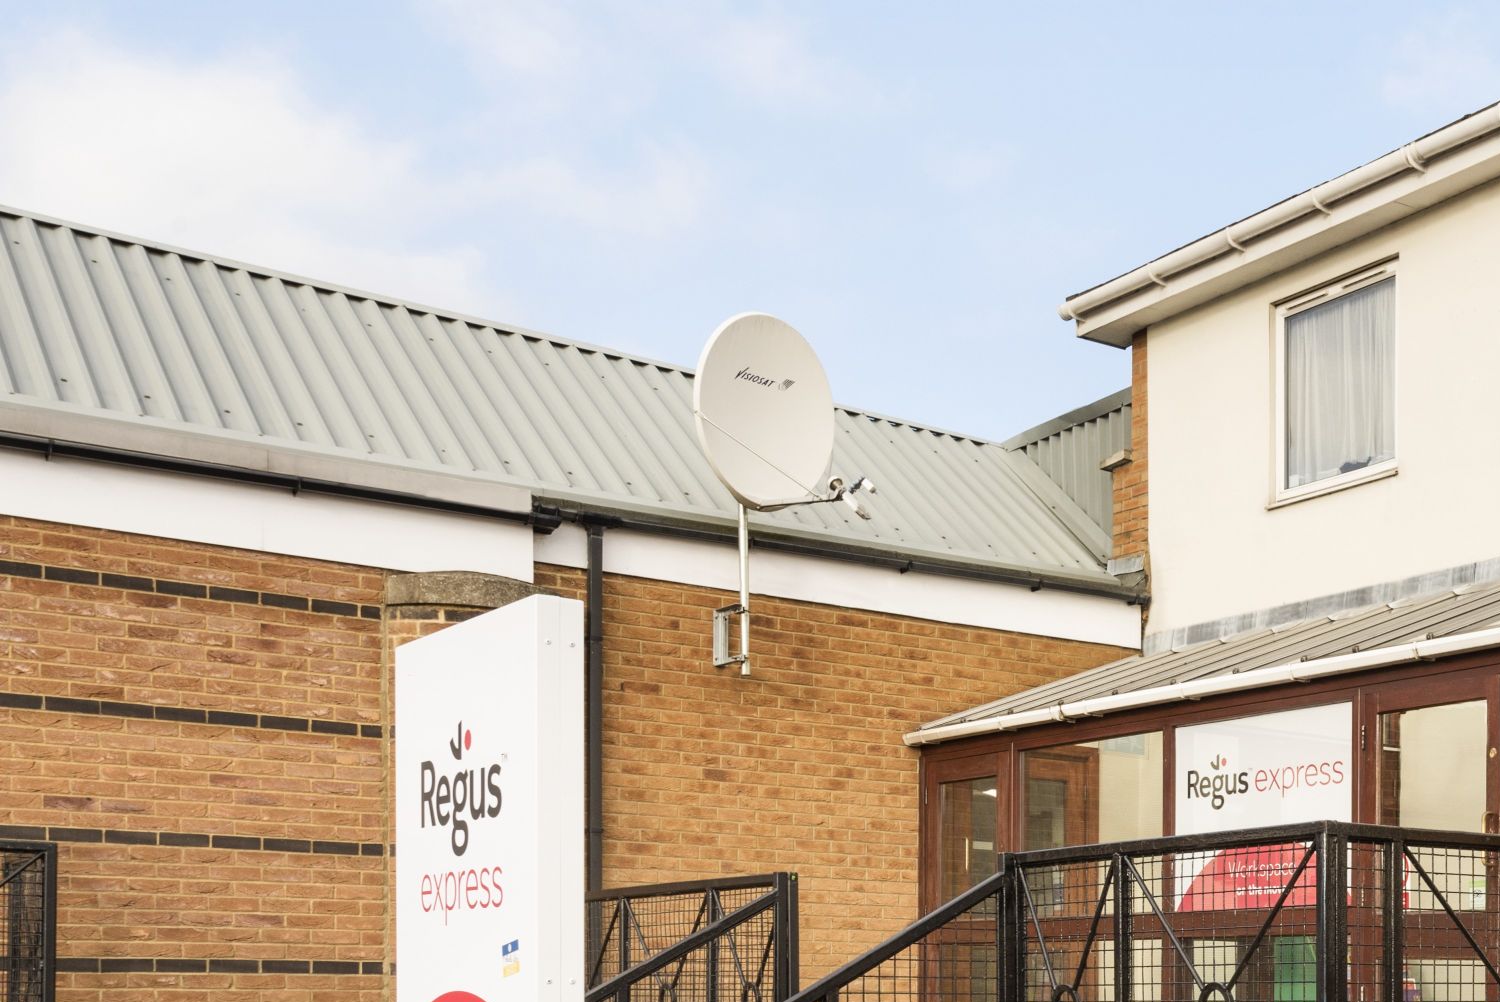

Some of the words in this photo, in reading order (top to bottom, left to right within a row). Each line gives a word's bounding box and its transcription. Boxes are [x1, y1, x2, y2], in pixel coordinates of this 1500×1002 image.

[734, 366, 776, 387] VISIOSAT
[420, 759, 503, 857] Regus
[1187, 769, 1249, 810] Regus
[1254, 760, 1345, 798] express
[420, 866, 504, 926] express
[1248, 883, 1262, 896] the
